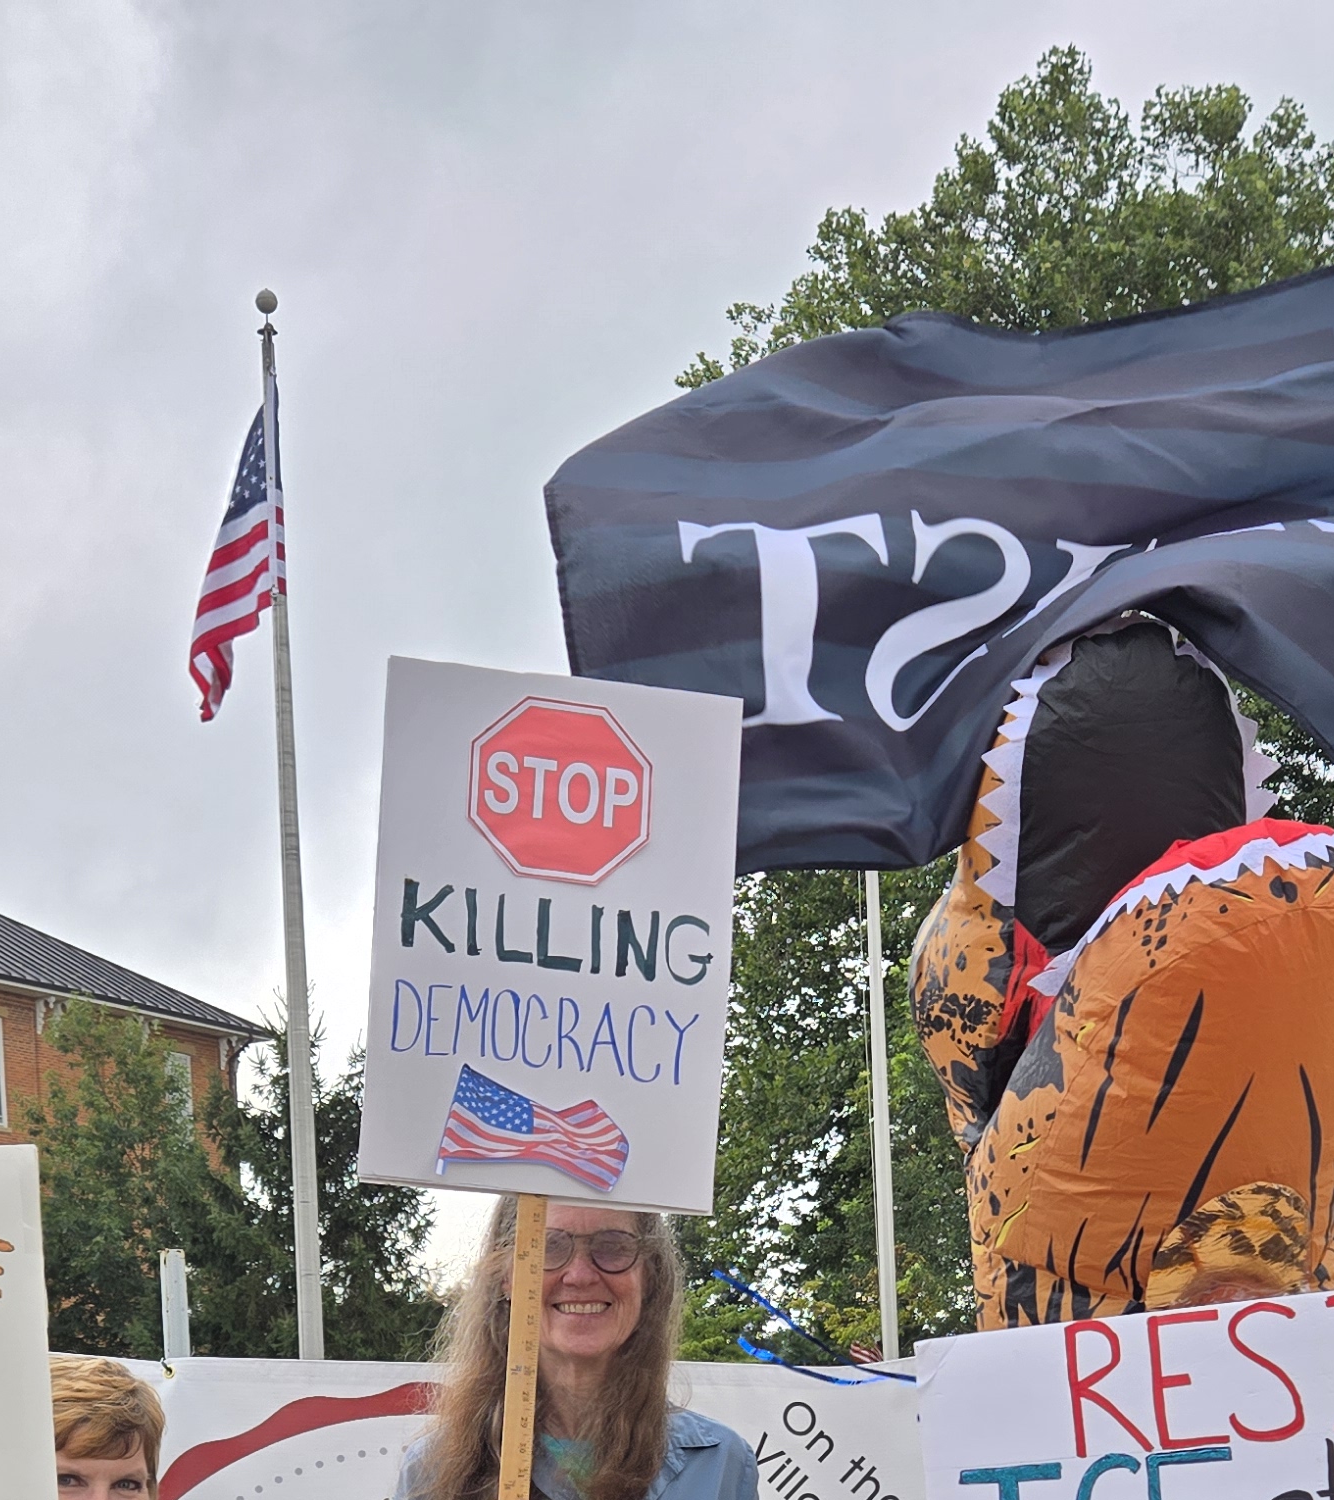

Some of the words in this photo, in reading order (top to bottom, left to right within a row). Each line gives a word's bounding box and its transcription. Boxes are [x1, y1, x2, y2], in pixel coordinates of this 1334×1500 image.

[483, 750, 640, 829] STOP
[400, 877, 714, 986] KILLING
[390, 979, 700, 1086] DEMOCRACY
[782, 1401, 835, 1463] On
